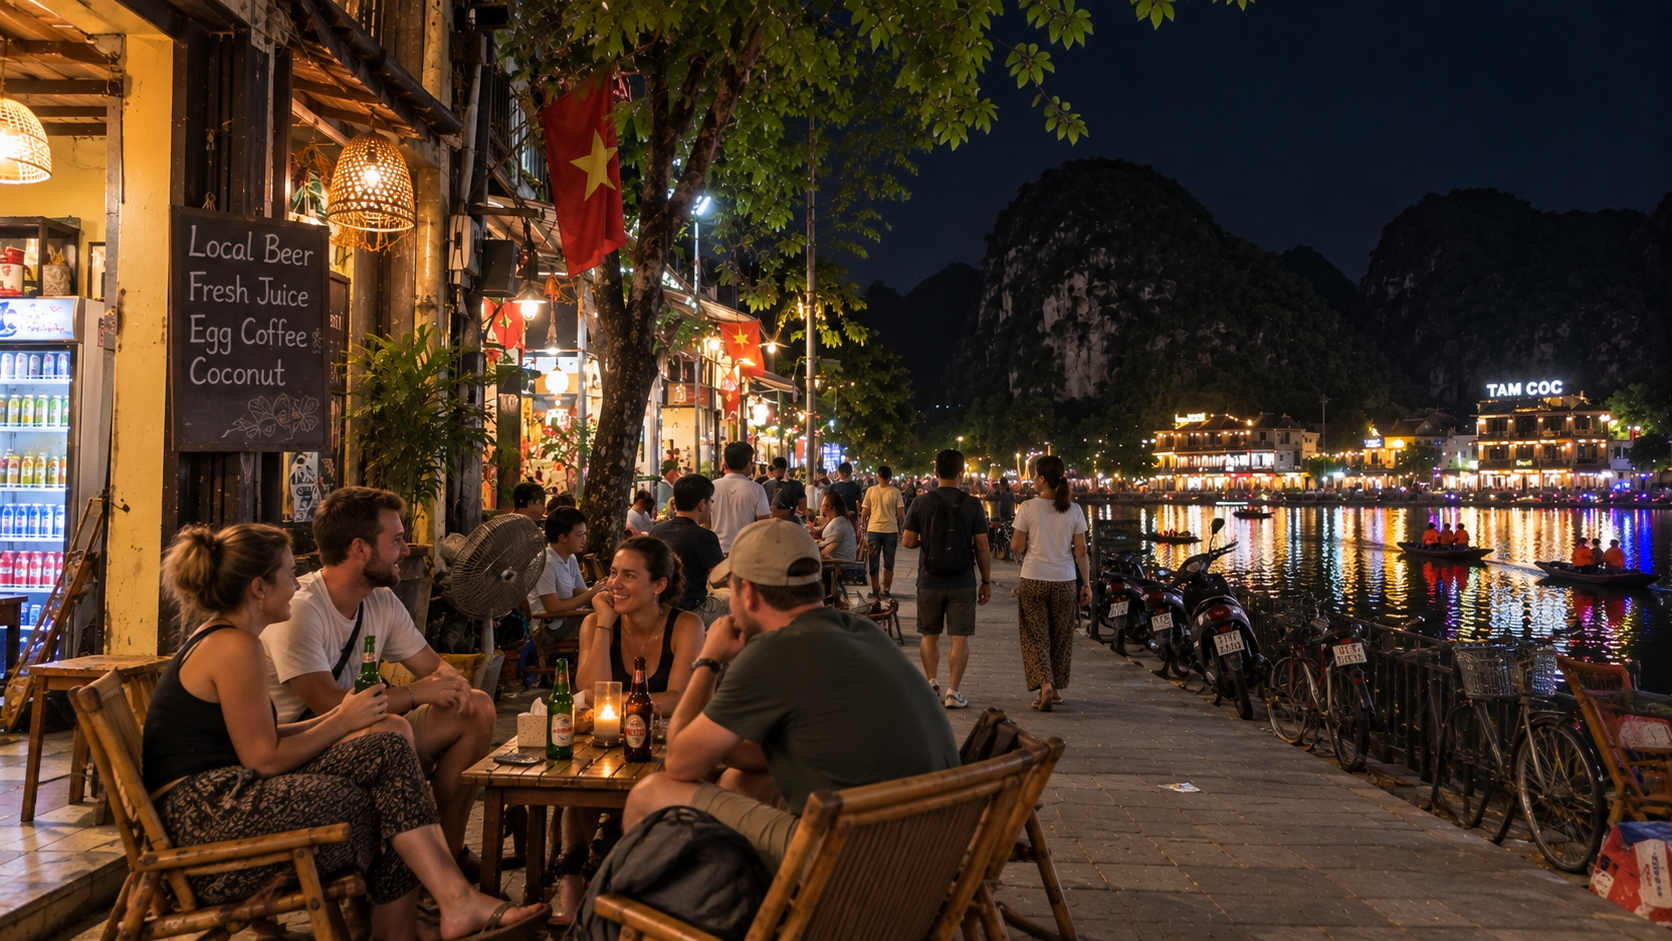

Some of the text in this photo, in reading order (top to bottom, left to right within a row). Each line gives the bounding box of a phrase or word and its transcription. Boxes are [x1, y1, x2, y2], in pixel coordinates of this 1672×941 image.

[189, 225, 314, 266] Local Beer
[189, 271, 309, 307] Fresh Juice
[189, 314, 232, 355] Egg
[241, 317, 308, 347] Coffee
[189, 356, 286, 386] Coconut
[1486, 380, 1563, 397] TAM COC
